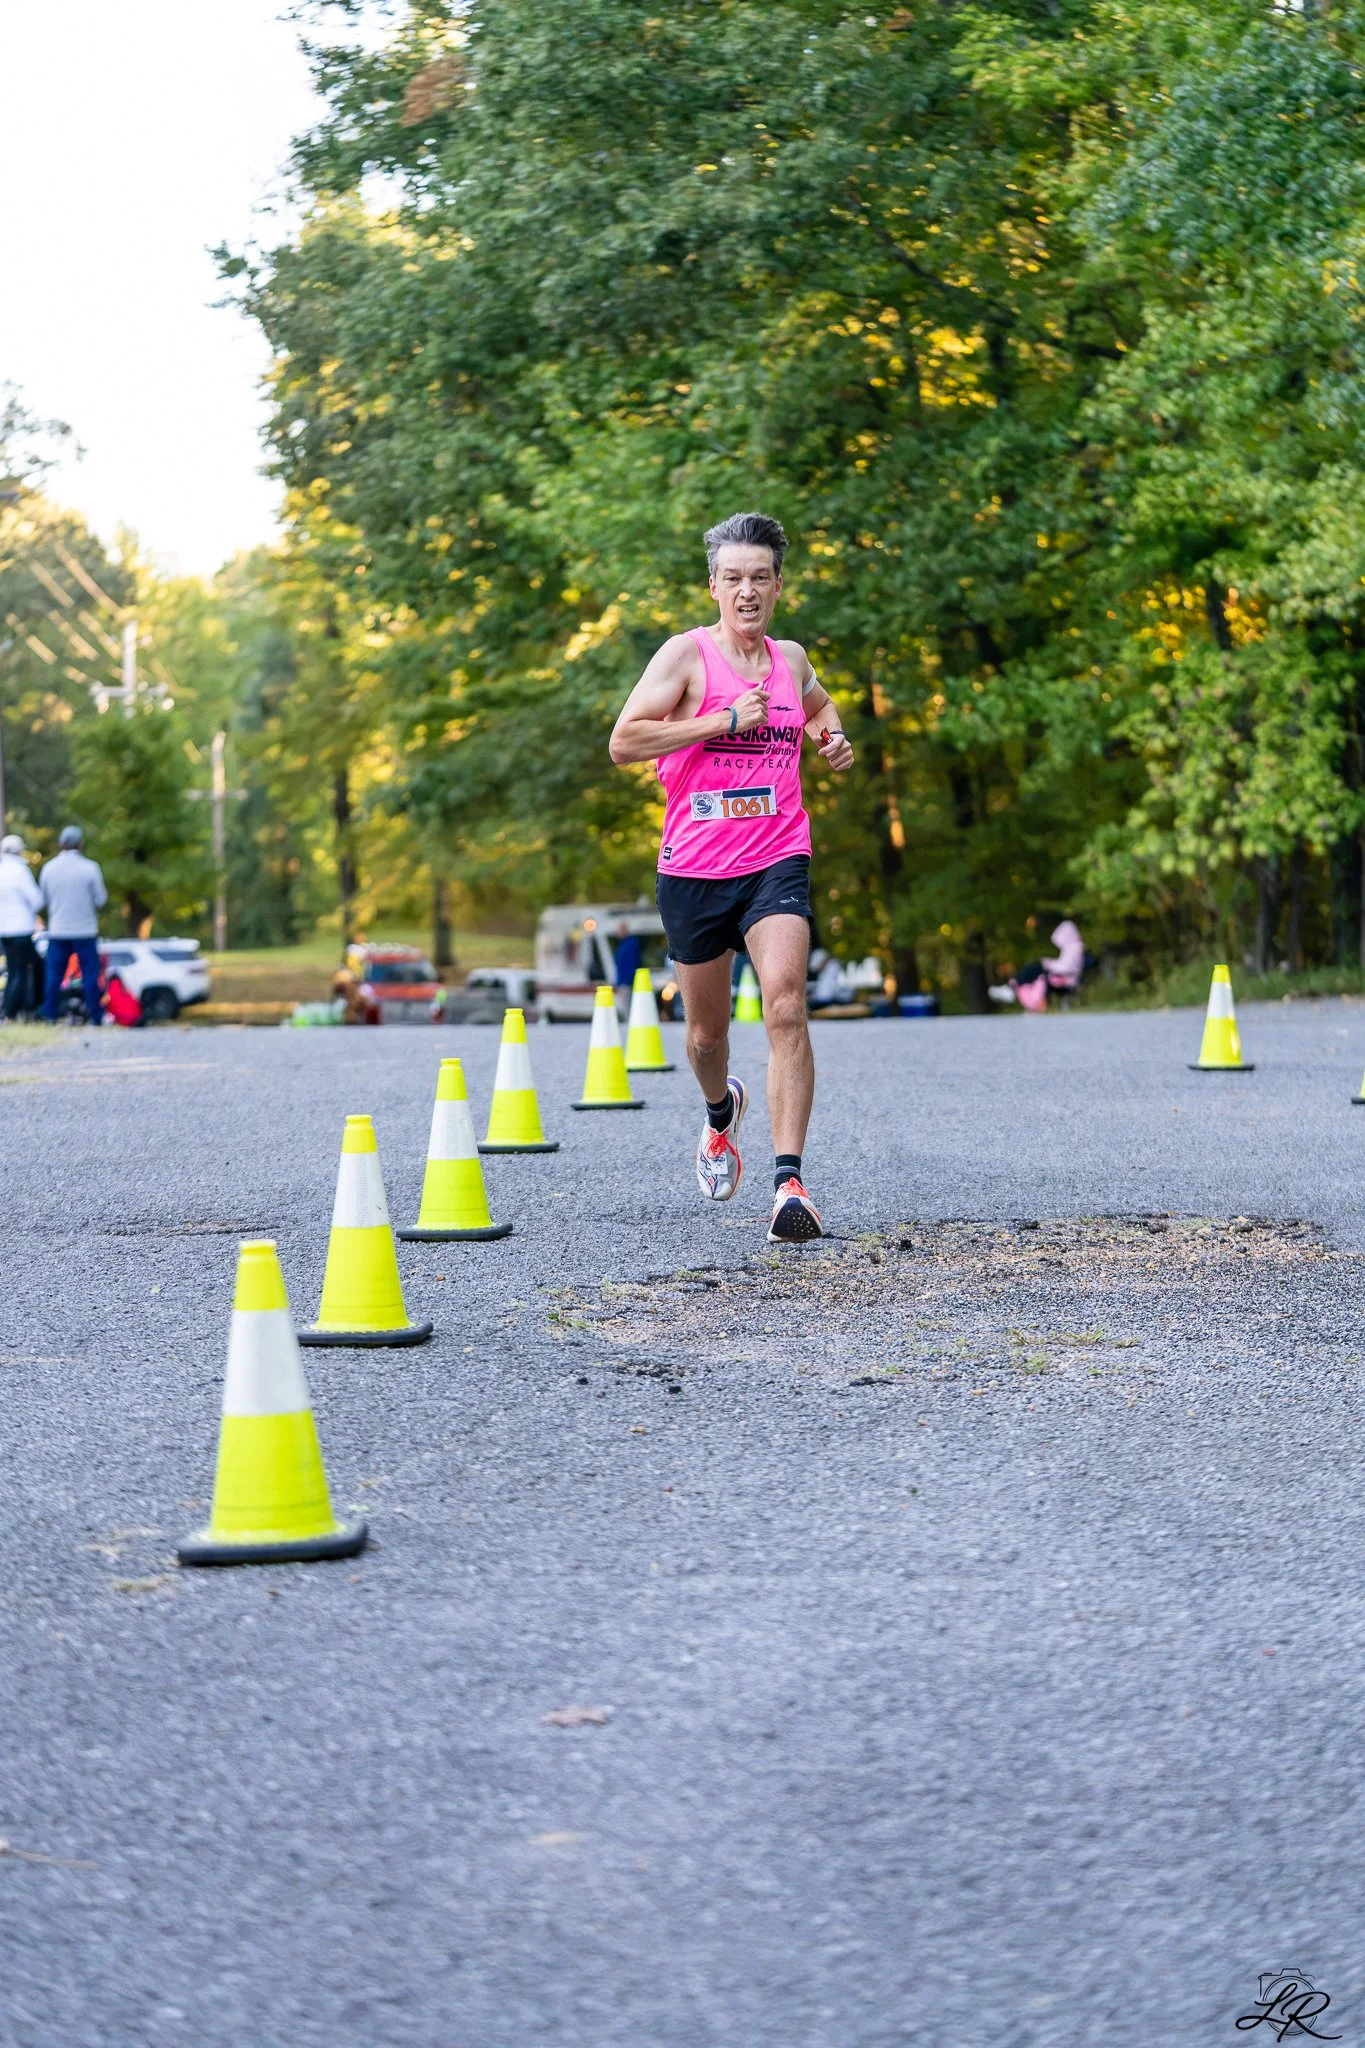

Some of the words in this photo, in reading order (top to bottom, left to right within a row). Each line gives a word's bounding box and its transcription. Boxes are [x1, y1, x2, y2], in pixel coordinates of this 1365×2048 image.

[713, 757, 754, 769] RACE
[761, 758, 792, 770] TEAM
[720, 796, 771, 818] 1061
